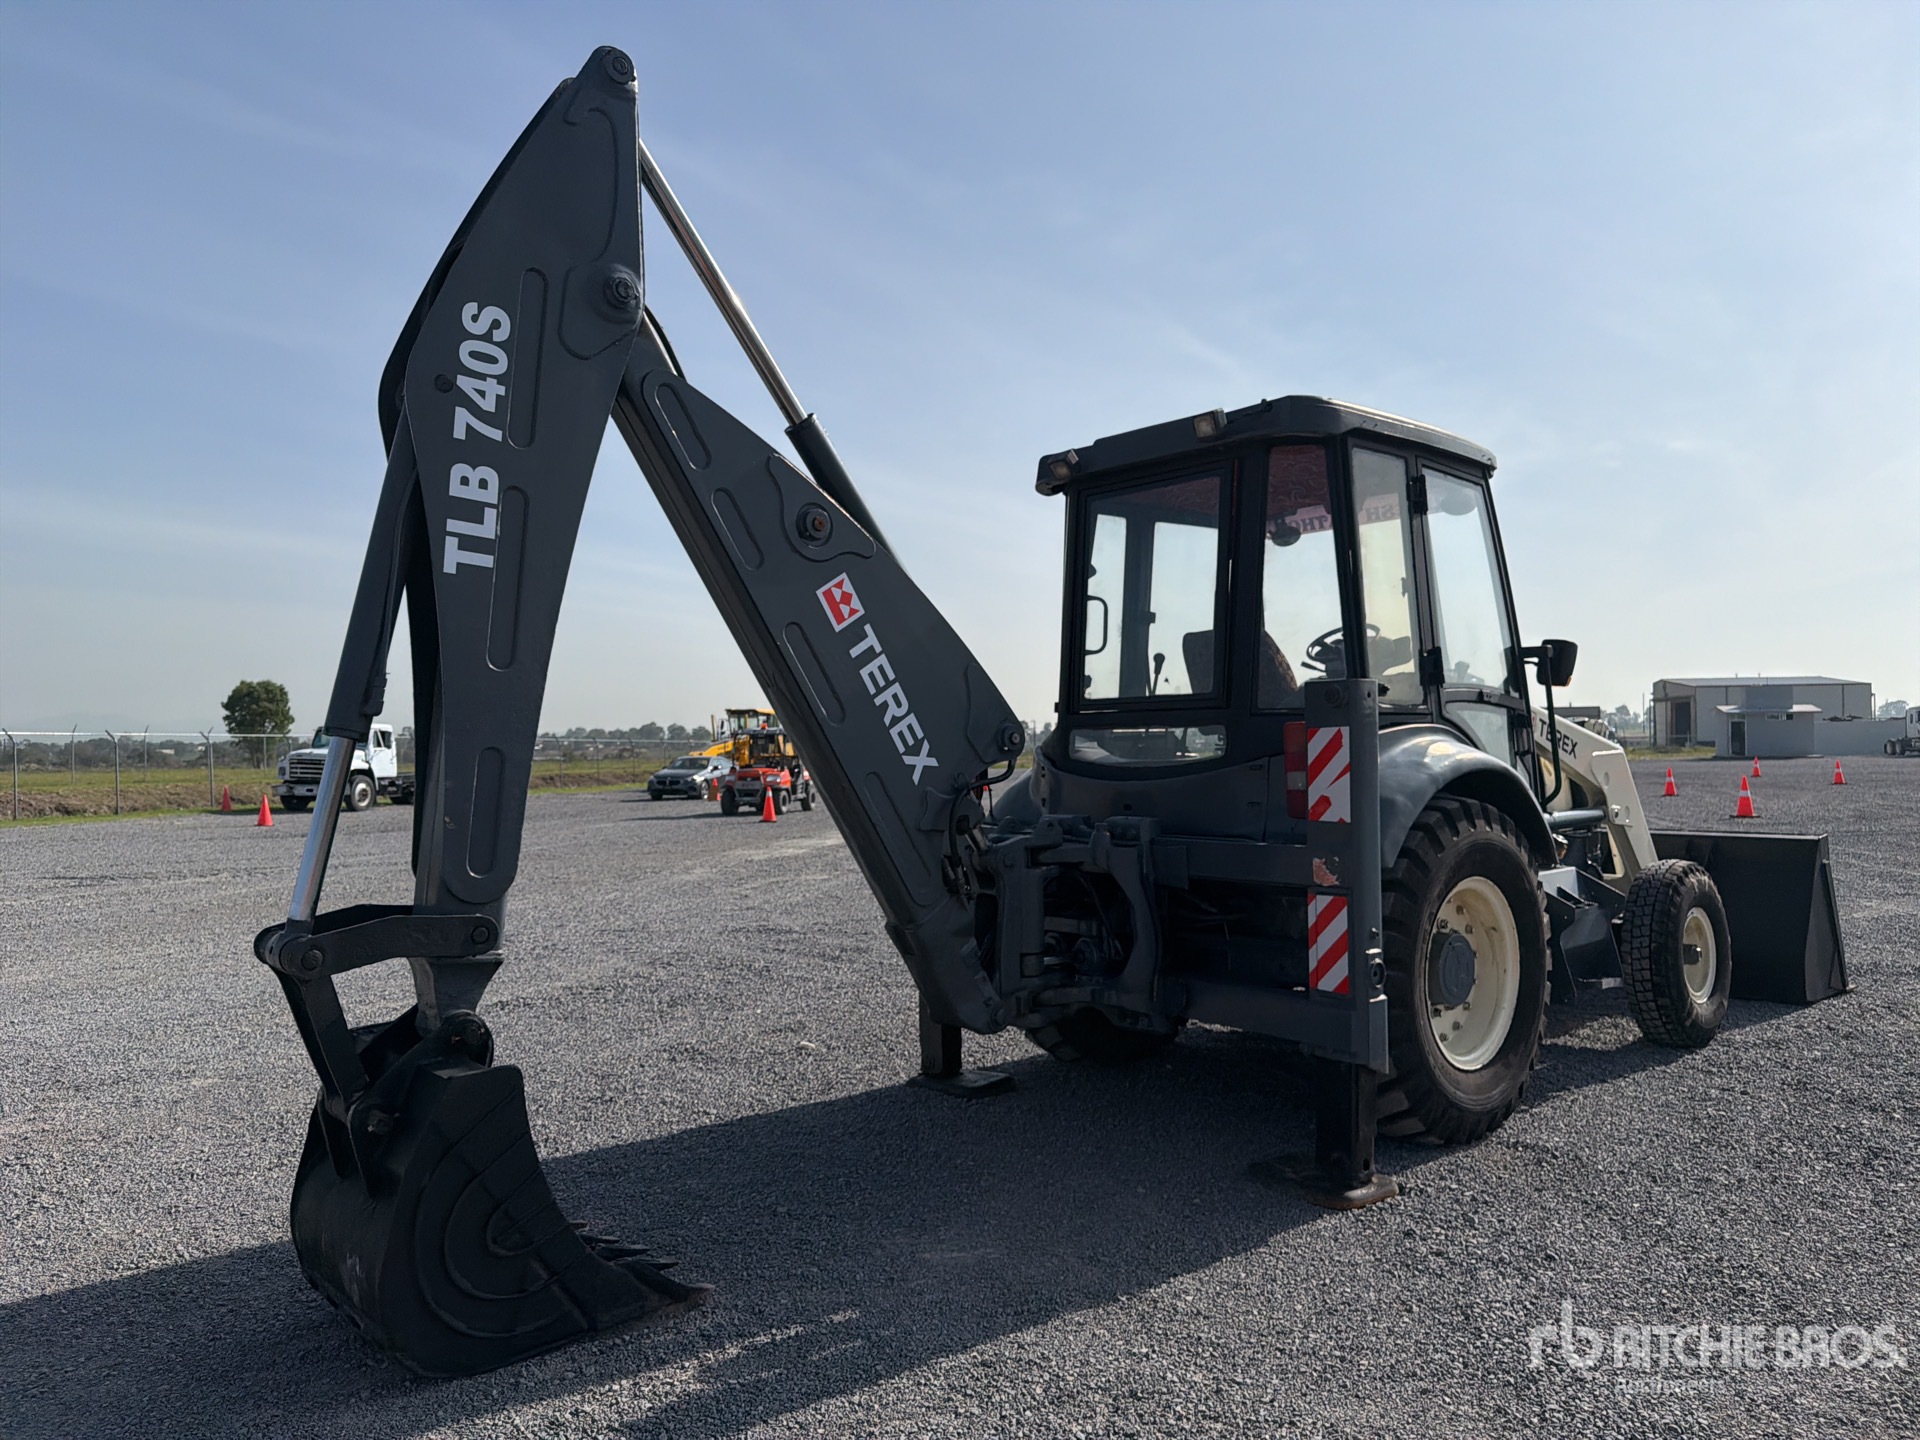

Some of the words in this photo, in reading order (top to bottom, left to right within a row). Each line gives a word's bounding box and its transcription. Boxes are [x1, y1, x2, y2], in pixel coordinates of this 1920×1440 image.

[453, 301, 511, 442] 740S
[443, 463, 499, 575] TLB
[849, 623, 939, 786] TEREX
